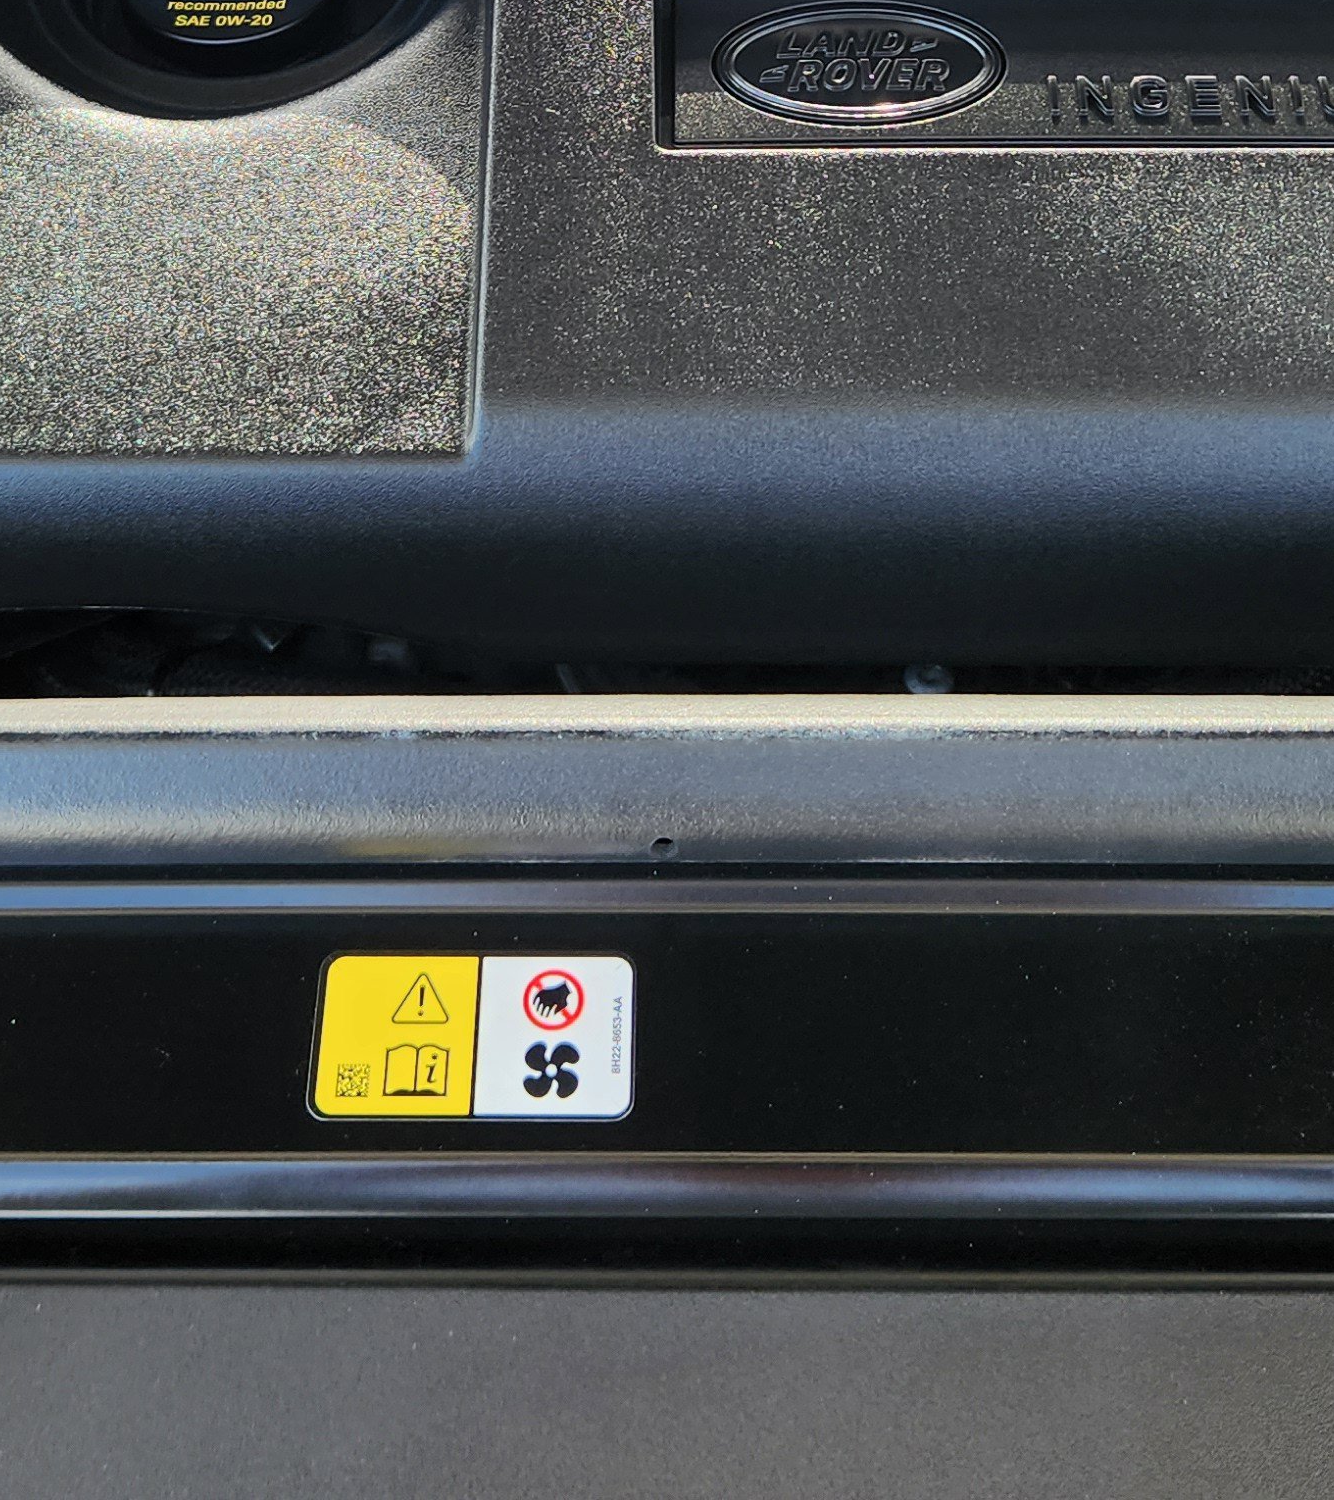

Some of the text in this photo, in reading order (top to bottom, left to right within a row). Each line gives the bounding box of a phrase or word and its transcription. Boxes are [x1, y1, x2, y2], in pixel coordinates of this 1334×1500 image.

[174, 14, 272, 26] SAE 0W-20
[776, 30, 907, 59] LAND
[787, 58, 949, 92] ROVER
